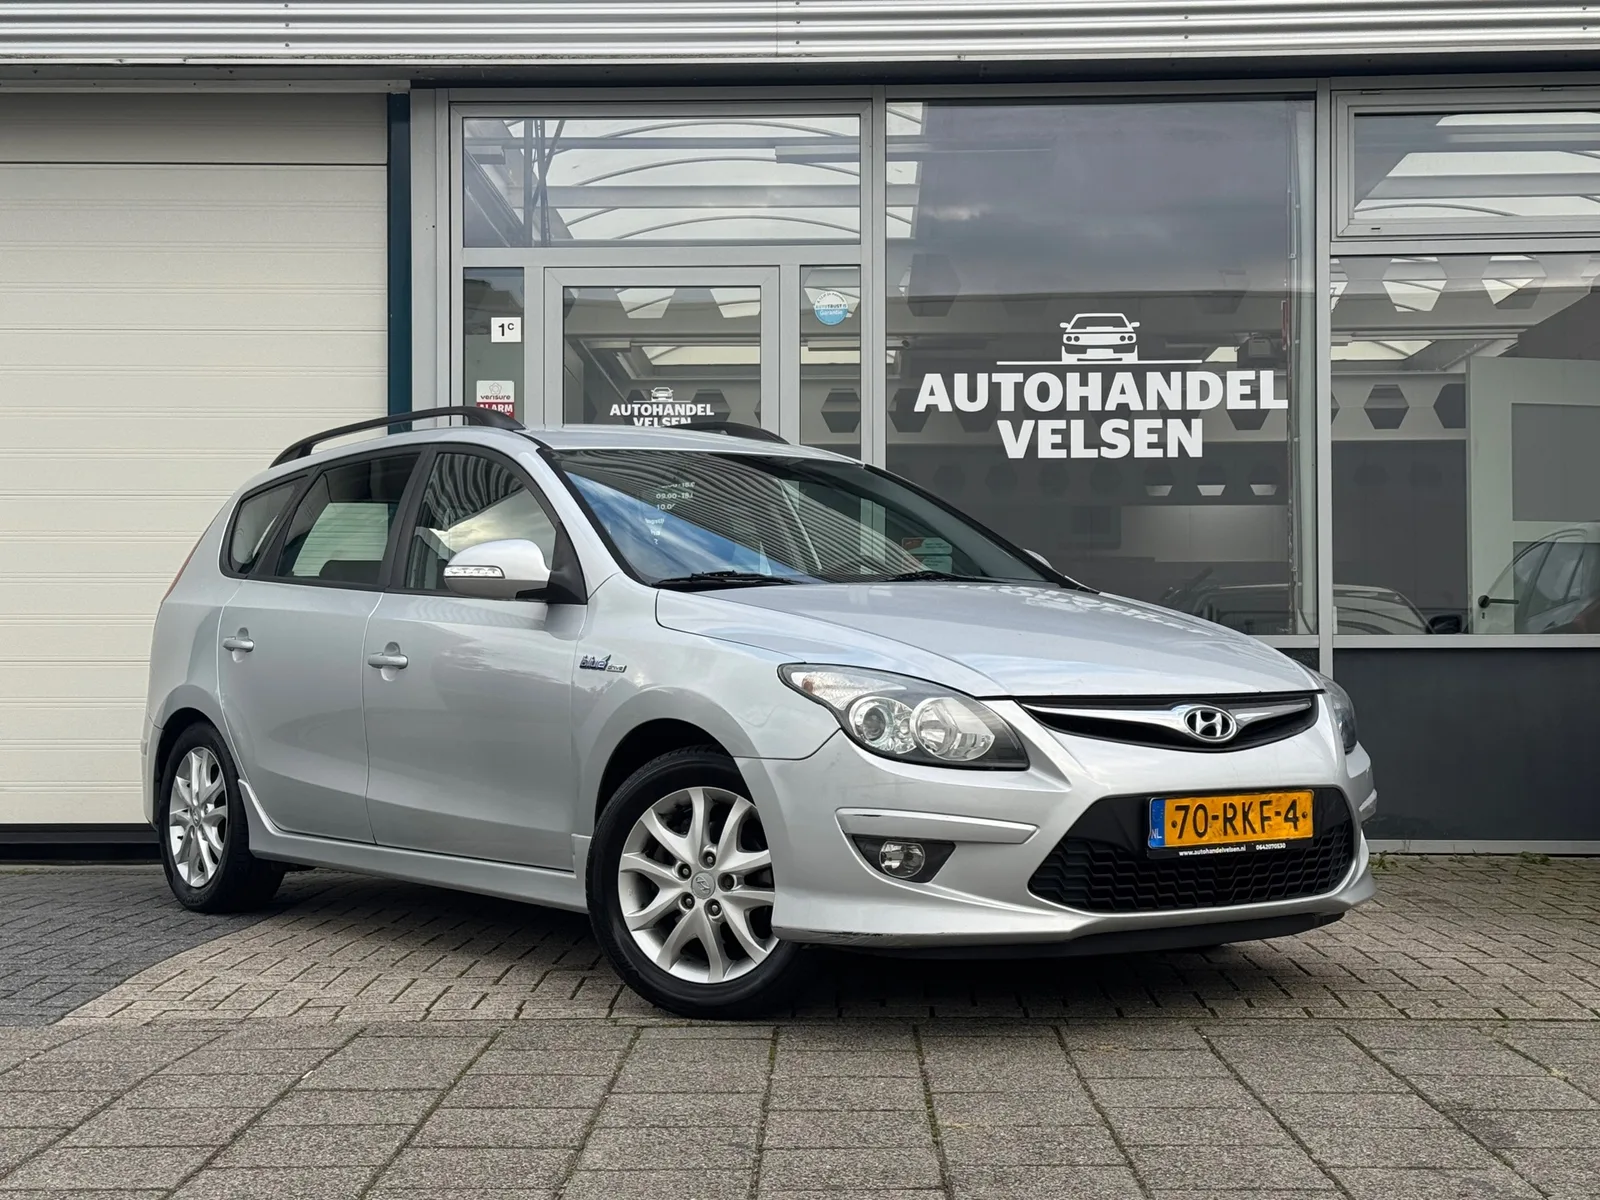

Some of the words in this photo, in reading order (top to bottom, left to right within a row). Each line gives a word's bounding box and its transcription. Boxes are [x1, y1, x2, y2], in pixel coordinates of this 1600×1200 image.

[913, 370, 1289, 412] AUTOHANDEL
[609, 403, 715, 416] AUTOHANDEL
[633, 417, 692, 428] VELSEN
[997, 418, 1203, 459] VELSEN
[1174, 799, 1300, 839] 70-RKF-4
[1150, 828, 1163, 839] NL
[1179, 845, 1247, 856] www.autohandelvelsen.nl
